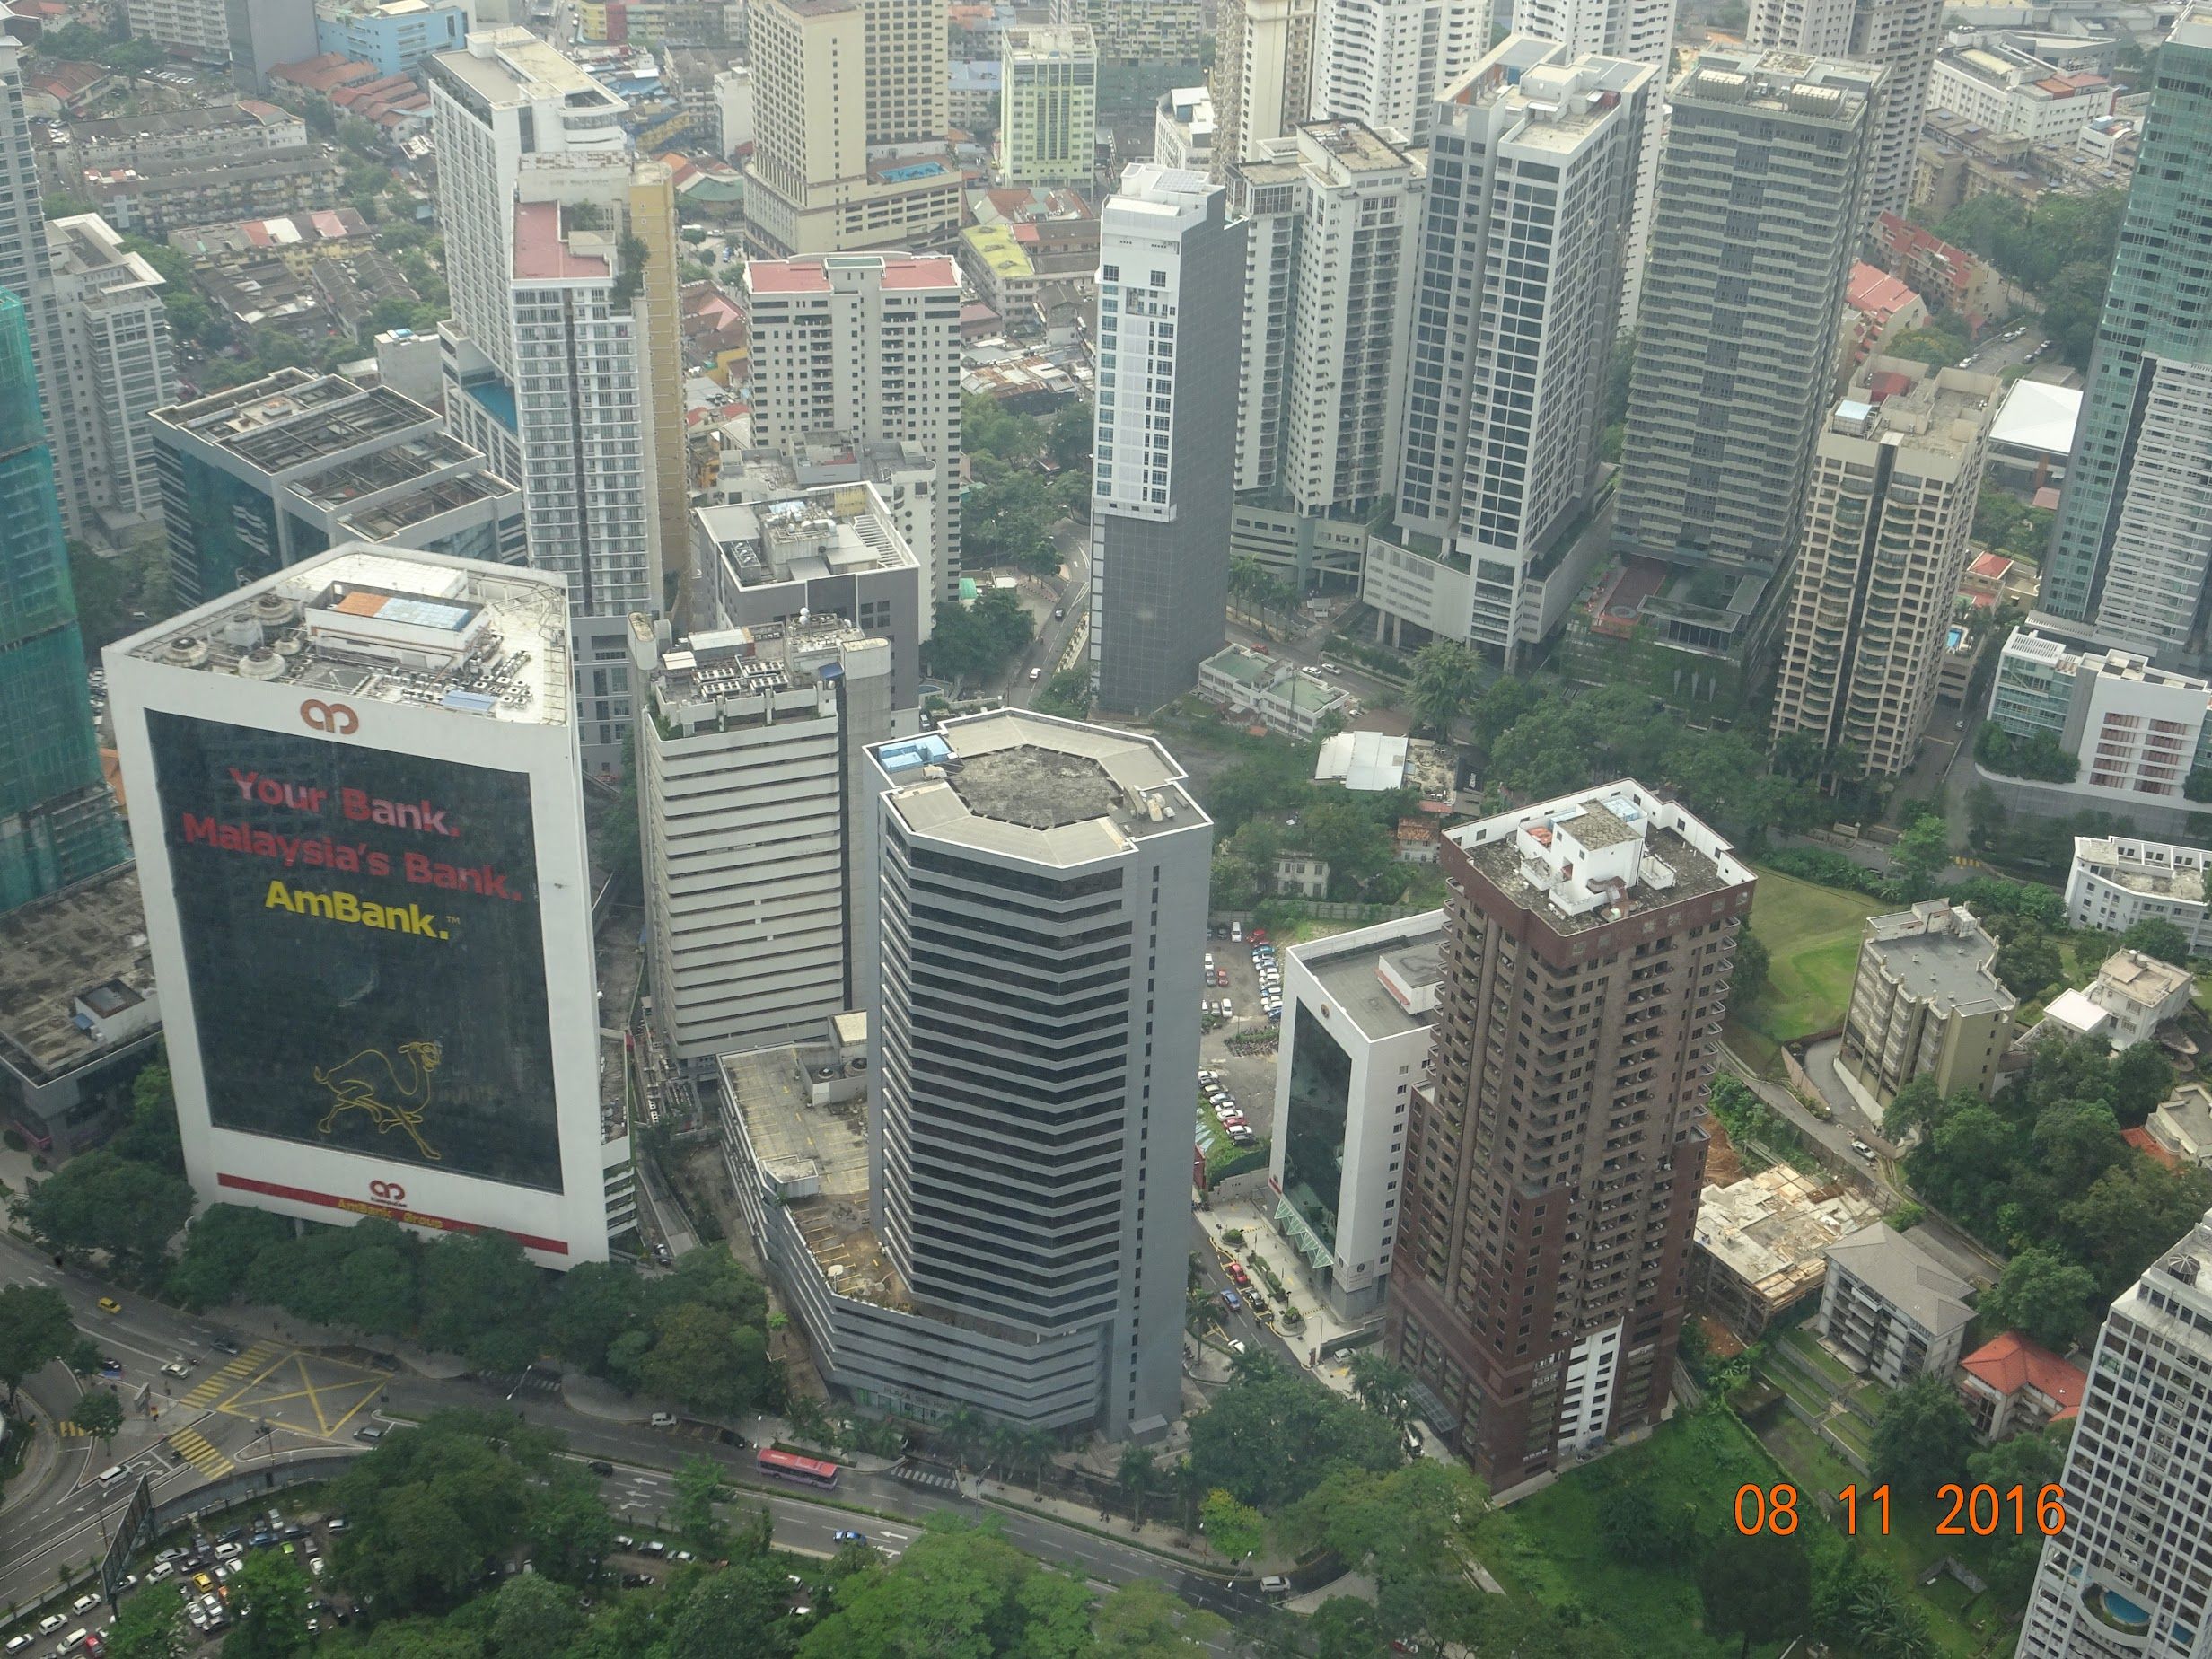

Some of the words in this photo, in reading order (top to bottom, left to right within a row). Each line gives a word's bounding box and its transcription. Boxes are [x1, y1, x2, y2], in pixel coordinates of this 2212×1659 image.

[228, 767, 329, 813] Your
[340, 786, 461, 838] Bank.
[182, 812, 391, 876] Malaysia's
[403, 851, 523, 902] Bank.
[337, 1198, 392, 1220] AmBank
[403, 1212, 443, 1229] Group
